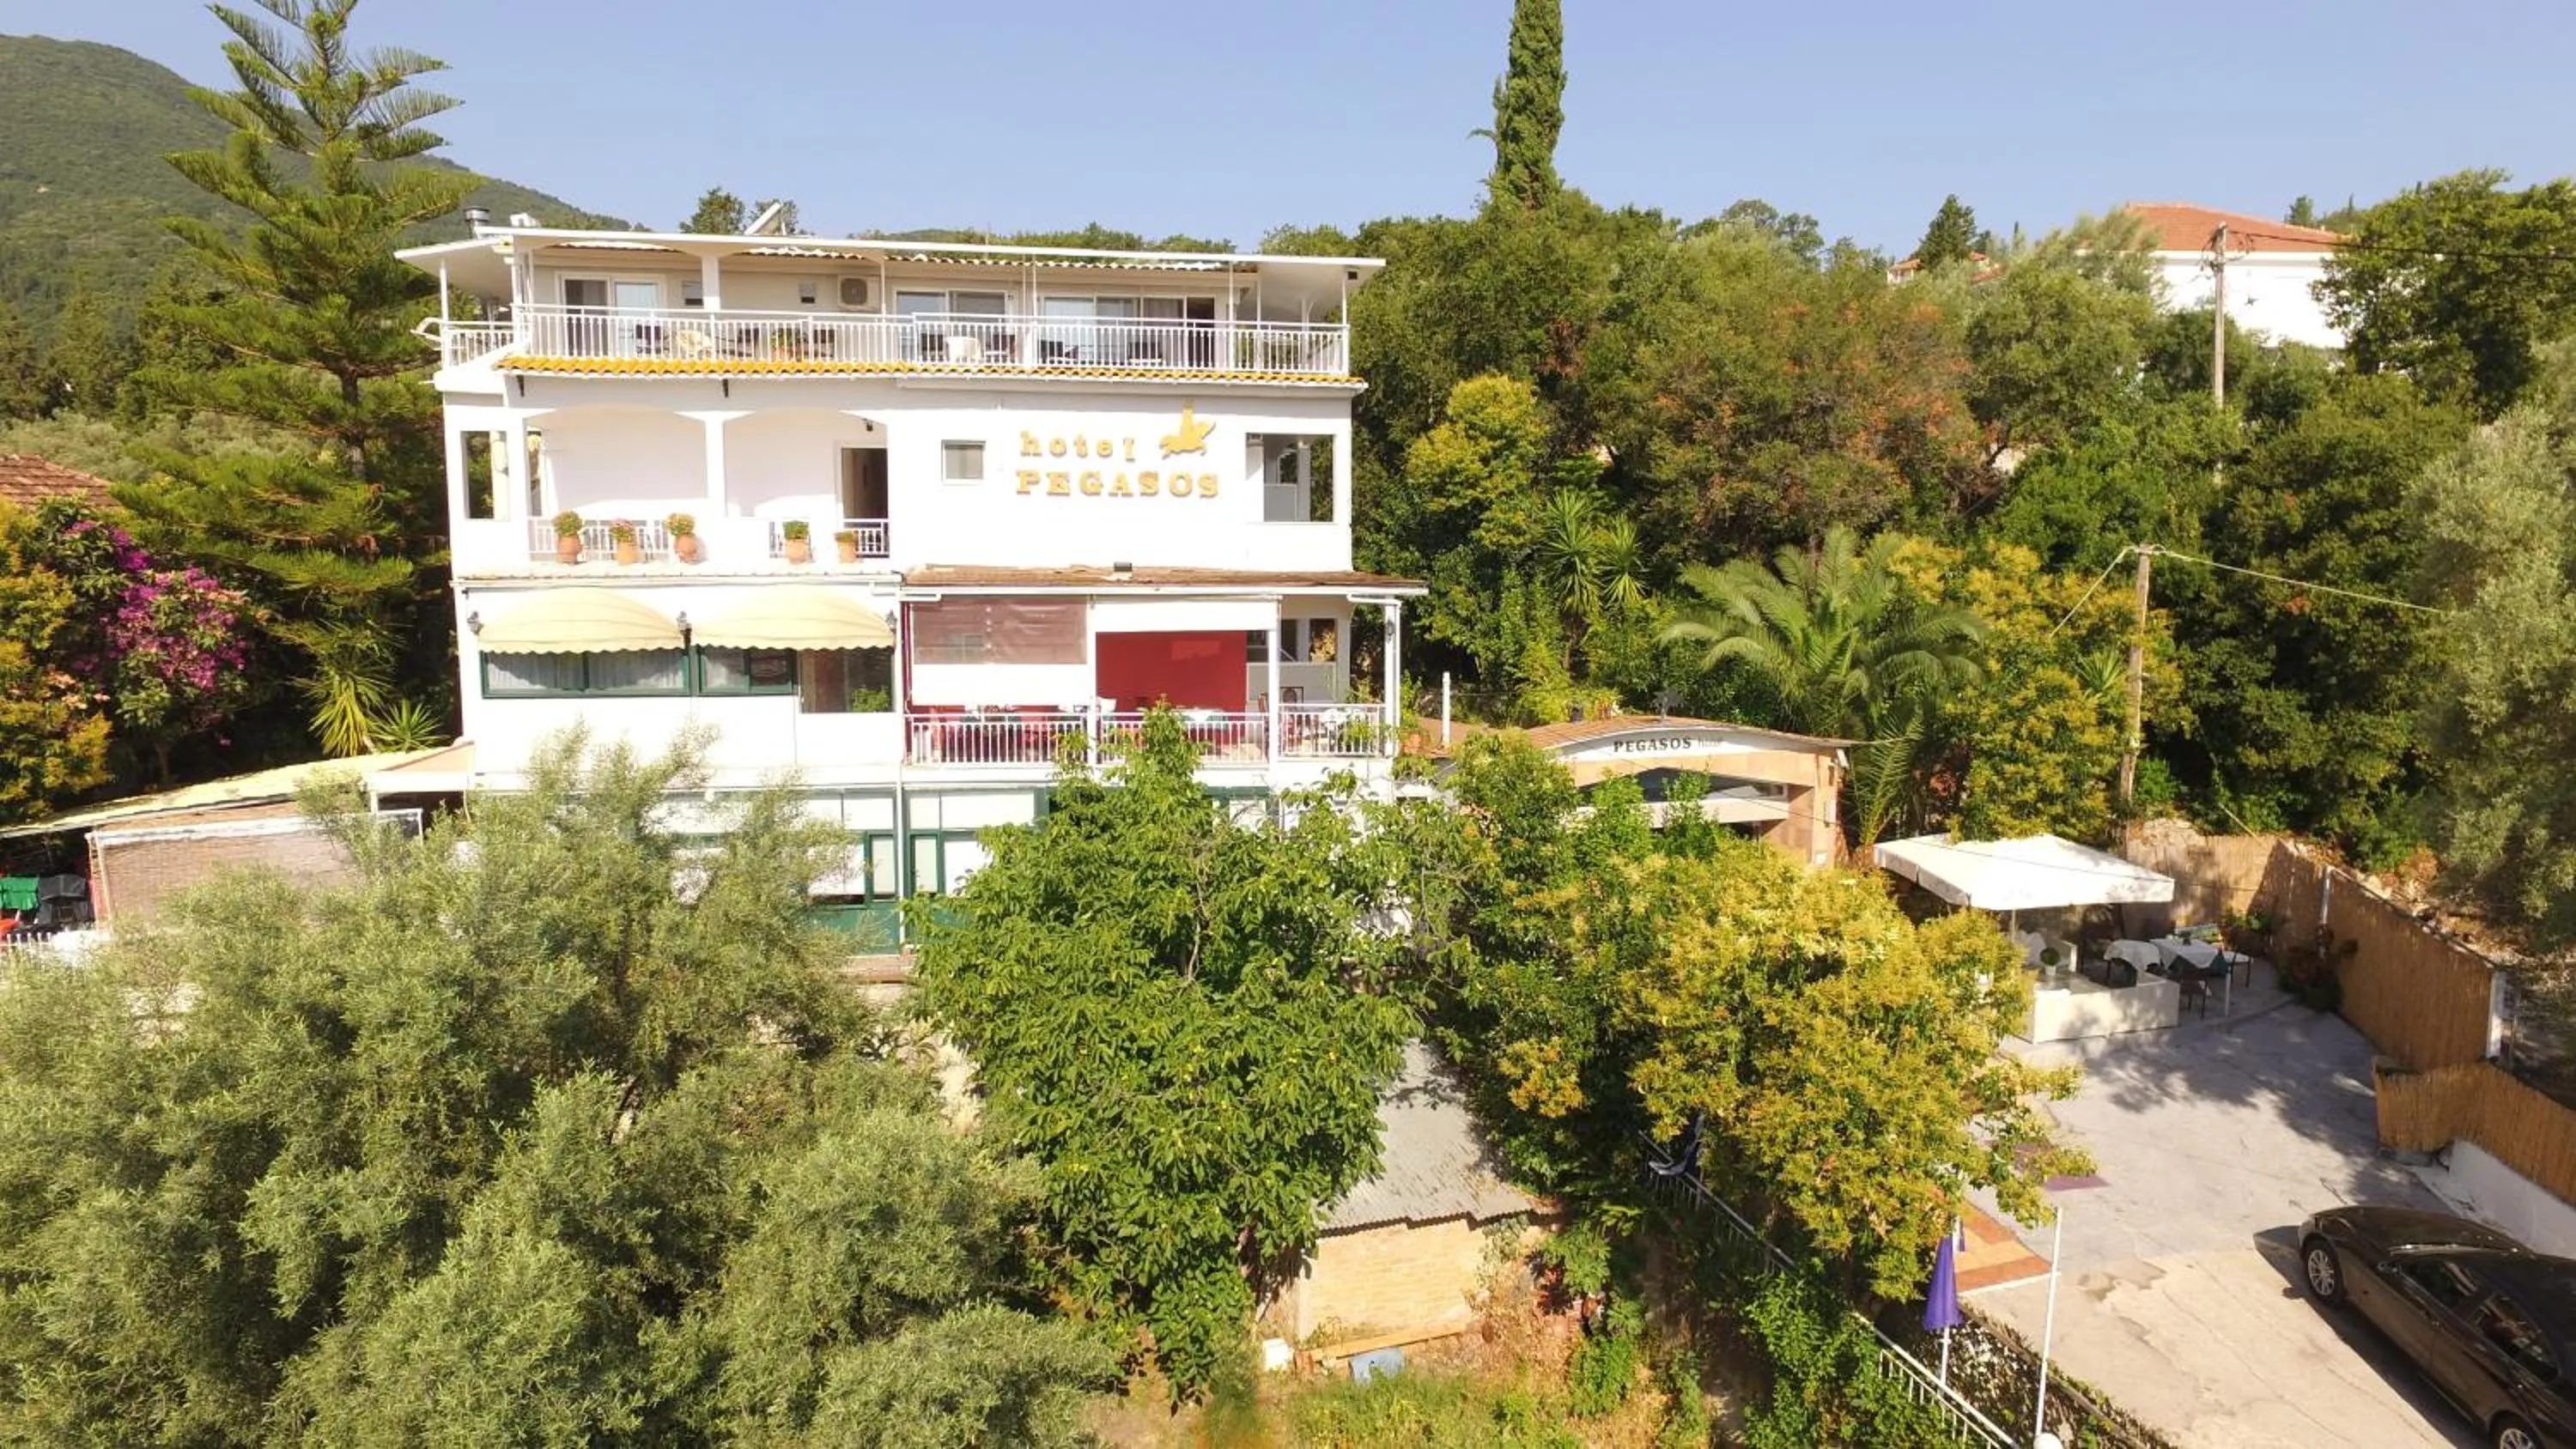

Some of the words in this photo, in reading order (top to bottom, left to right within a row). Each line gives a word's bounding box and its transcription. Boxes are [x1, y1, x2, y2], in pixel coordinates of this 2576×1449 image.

[1020, 430, 1136, 462] hotel
[1016, 470, 1219, 498] PEGASOS
[1613, 737, 1692, 752] PEGASOS
